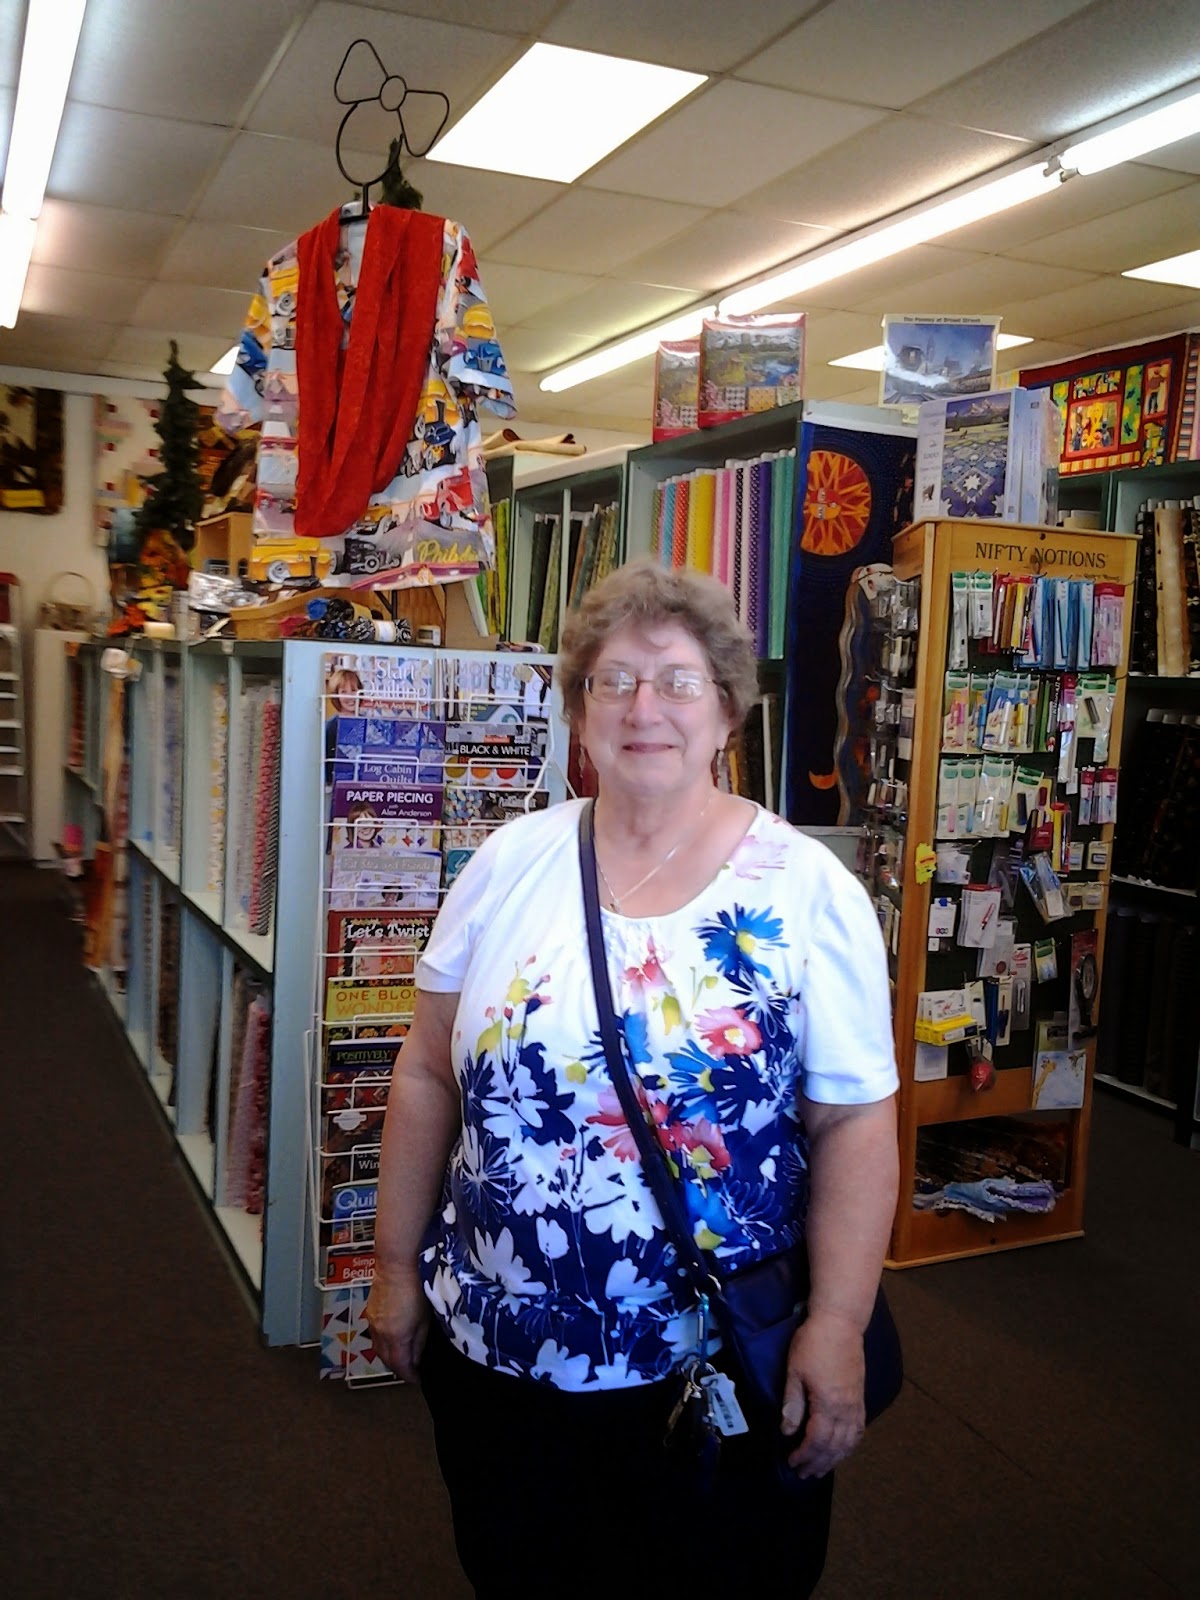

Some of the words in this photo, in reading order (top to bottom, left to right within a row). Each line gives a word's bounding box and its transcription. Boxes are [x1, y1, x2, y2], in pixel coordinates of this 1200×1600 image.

[975, 542, 1028, 561] NIFTY
[1034, 547, 1107, 569] NOTIONS
[376, 660, 416, 680] Start
[460, 745, 491, 755] BLACK
[492, 746, 499, 754] &
[501, 746, 531, 756] WHITE
[363, 763, 382, 775] Log
[384, 764, 412, 775] Cabin
[380, 774, 413, 784] Quilts
[346, 791, 385, 802] PAPER
[387, 792, 434, 804] PIECING
[398, 809, 432, 817] Anderson
[346, 923, 384, 939] Let's
[387, 923, 430, 938] Twist
[336, 1050, 391, 1061] POSITIVELY
